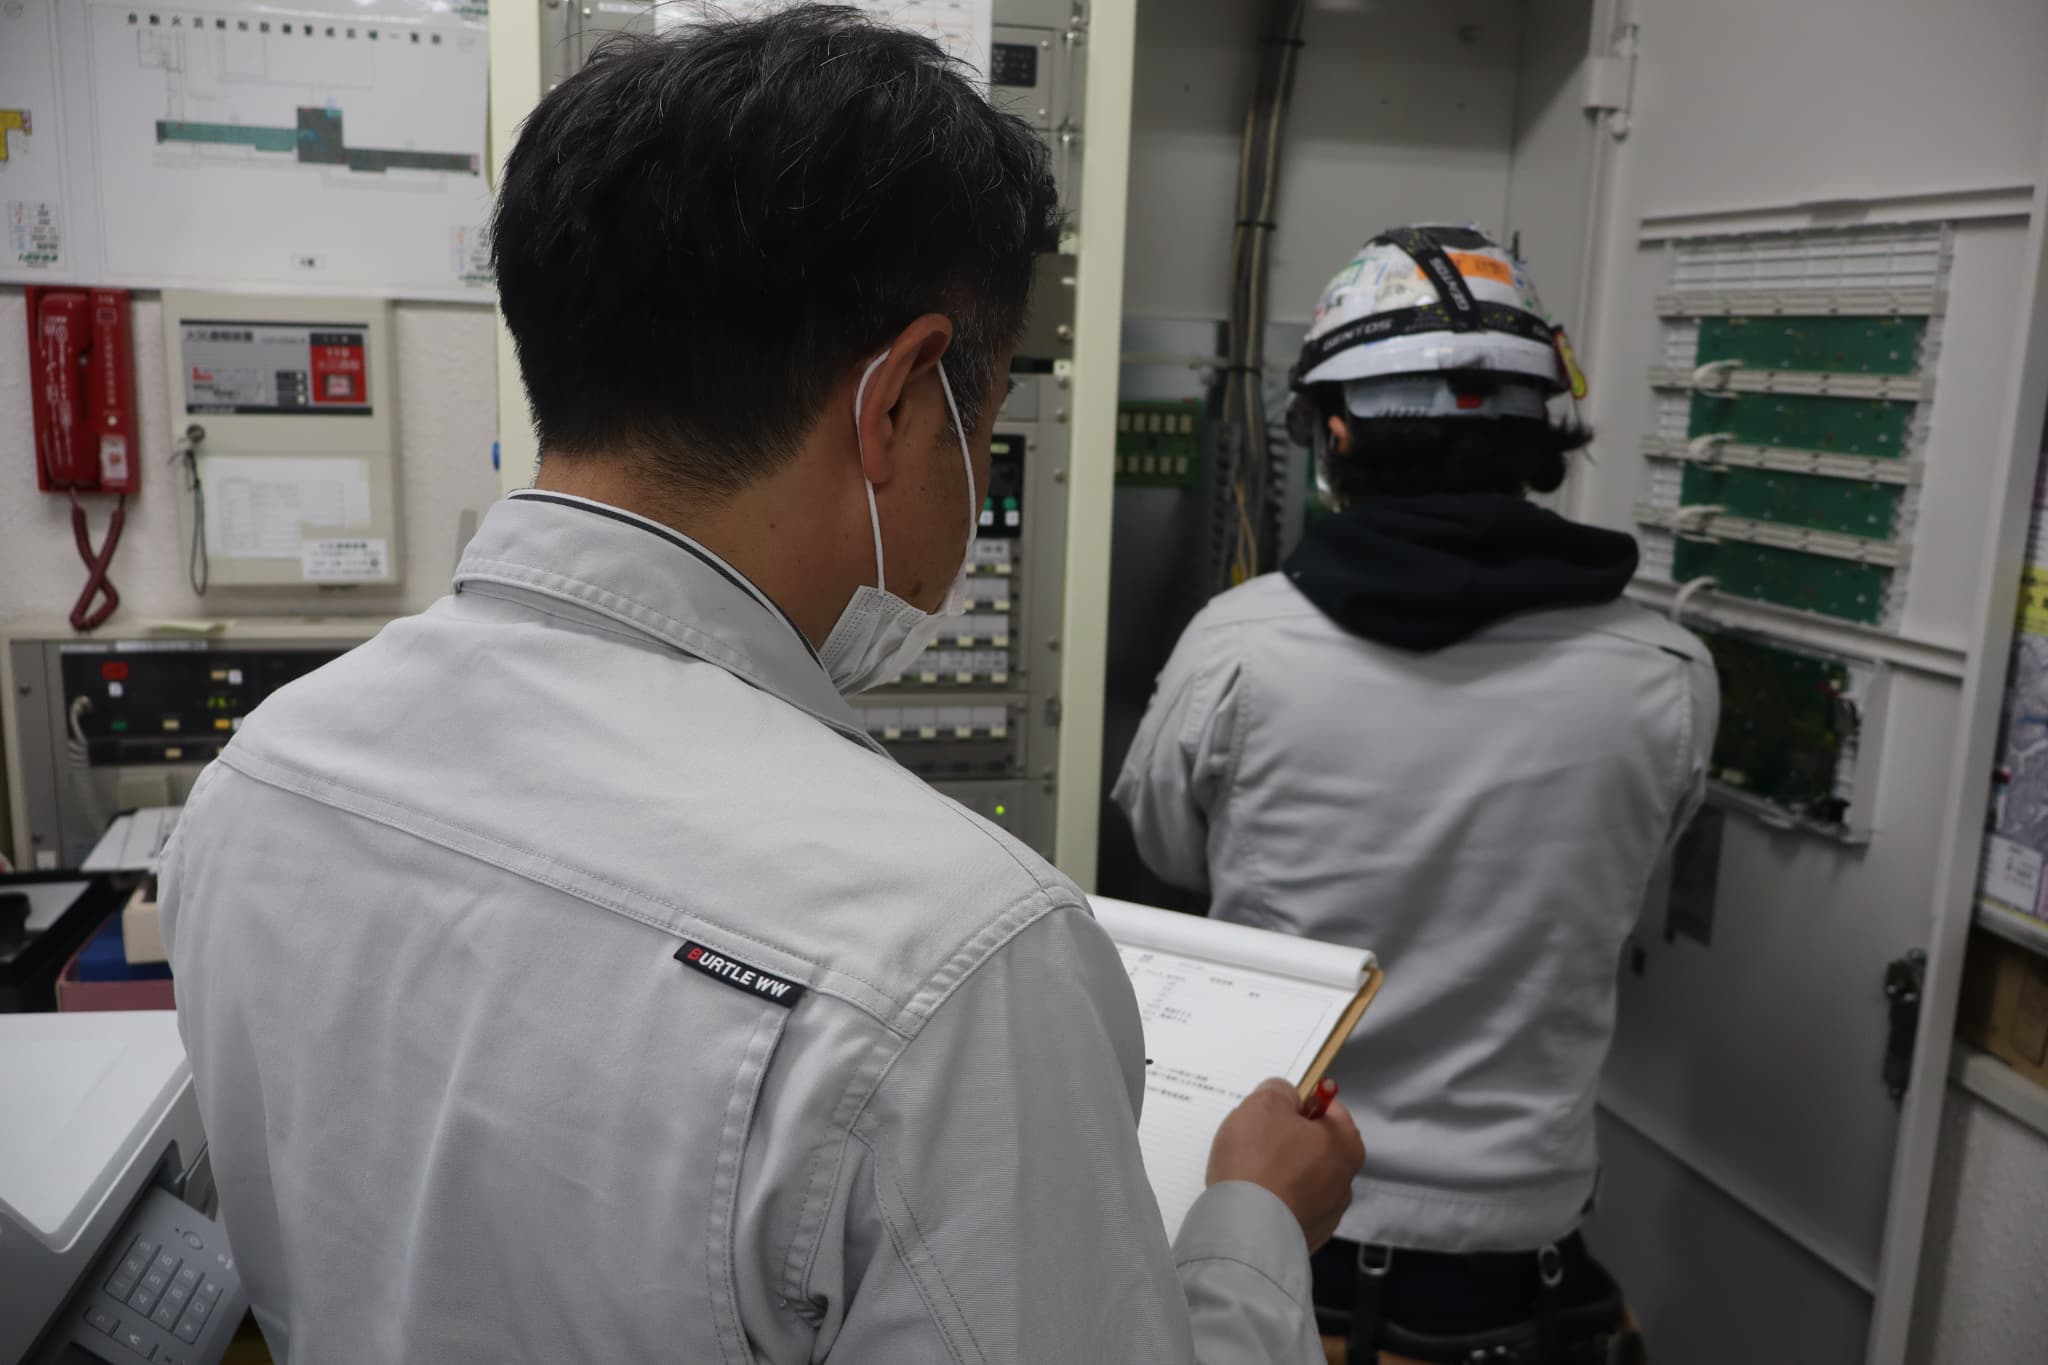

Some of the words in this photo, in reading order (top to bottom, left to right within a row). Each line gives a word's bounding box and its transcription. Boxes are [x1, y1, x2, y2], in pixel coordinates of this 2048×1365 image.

[1322, 318, 1393, 351] GENTOS
[687, 947, 756, 985] BURTLE
[755, 976, 791, 998] WW
